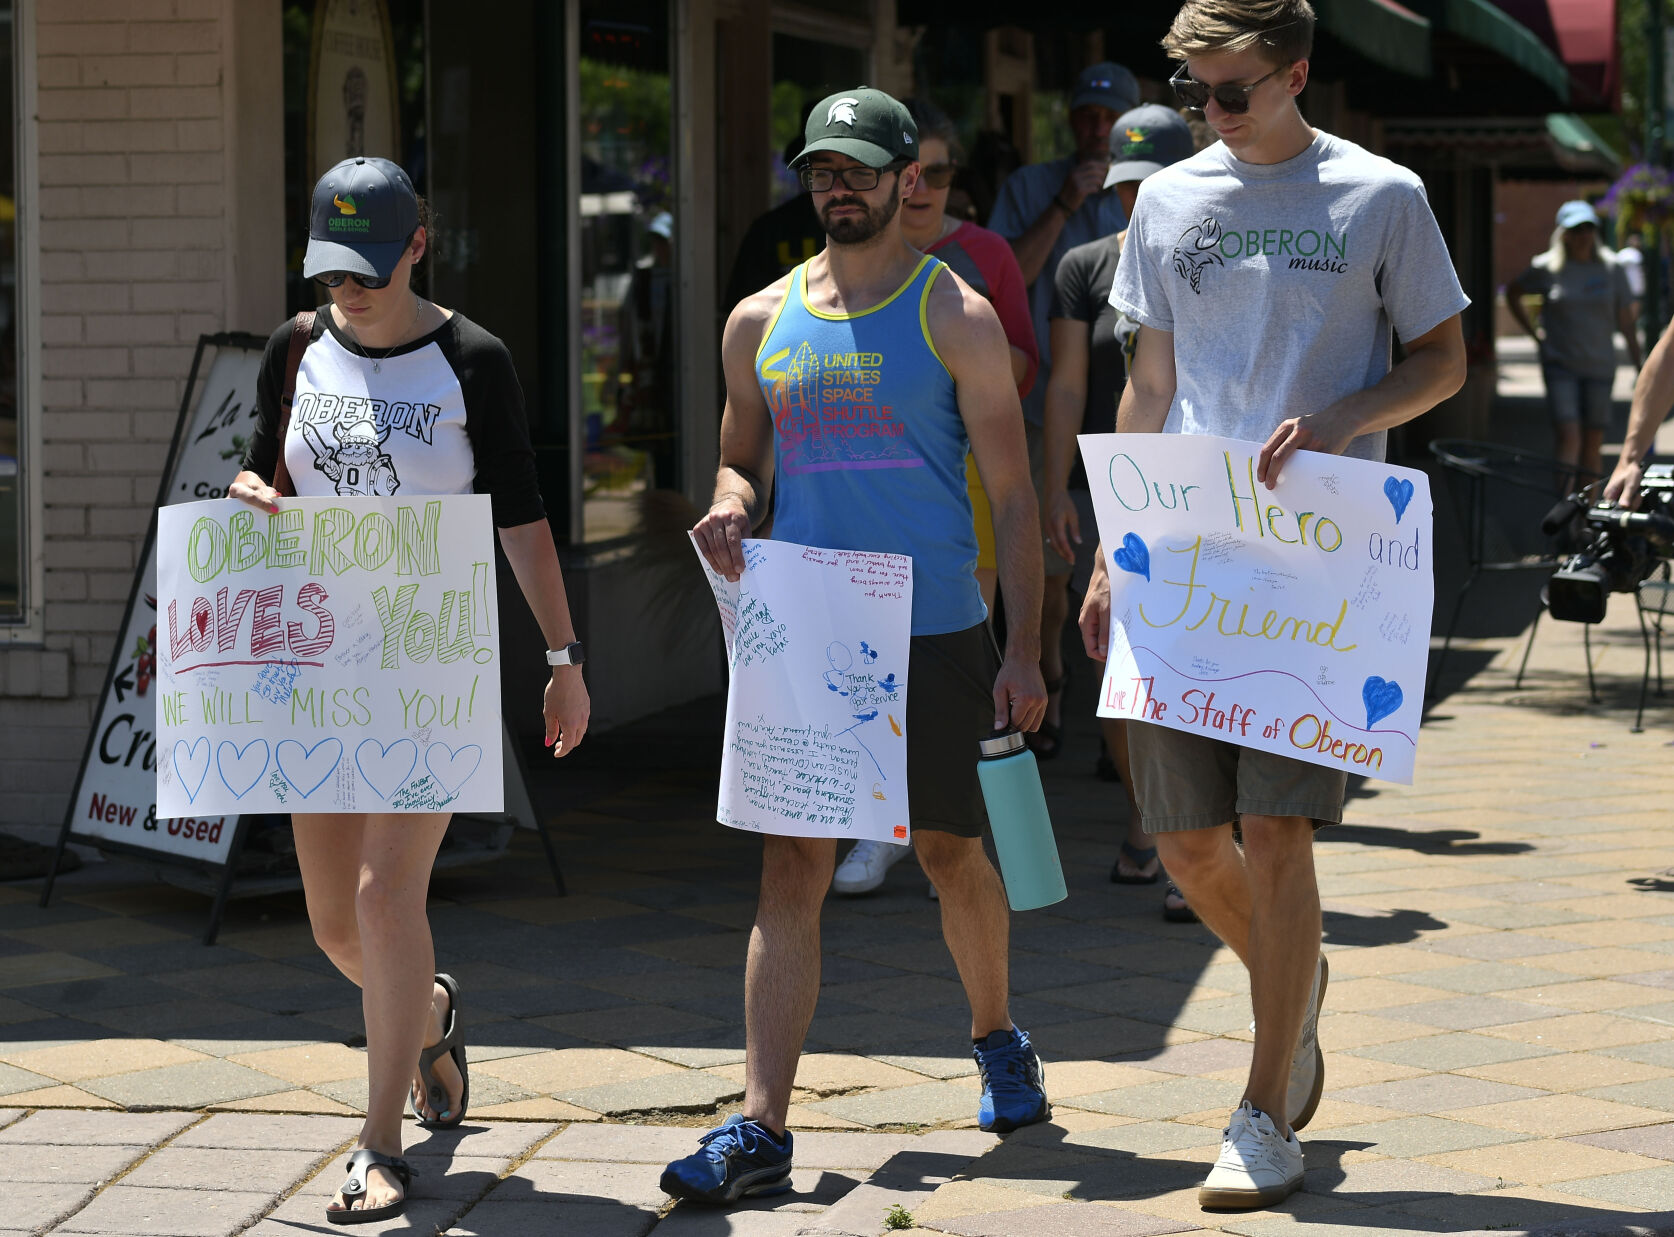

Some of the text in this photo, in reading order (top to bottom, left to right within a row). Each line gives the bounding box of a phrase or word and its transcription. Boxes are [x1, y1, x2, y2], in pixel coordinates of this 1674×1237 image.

[328, 217, 371, 227] OBERON
[1219, 229, 1347, 260] OBERON
[1288, 256, 1348, 274] music
[824, 352, 884, 368] UNITED
[822, 370, 881, 386] STATES
[822, 388, 873, 403] SPACE
[194, 388, 243, 445] La
[294, 392, 441, 446] OBERON
[822, 406, 893, 421] SHUTTLE
[823, 423, 904, 440] PROGRAM
[1109, 453, 1200, 512] Our
[1223, 450, 1343, 553] Hero
[1368, 527, 1420, 571] and
[187, 500, 442, 584] OBERON
[864, 589, 902, 600] Thank you
[1138, 535, 1358, 652] Friend
[168, 582, 335, 662] LOVES
[845, 673, 875, 683] Thank
[163, 674, 479, 730] WE WILL MISS YOU!
[870, 692, 899, 704] Service
[1106, 675, 1383, 773] Love The Staff of Oberon
[813, 740, 837, 752] duty
[88, 792, 225, 844] New & Used
[820, 815, 835, 826] are
